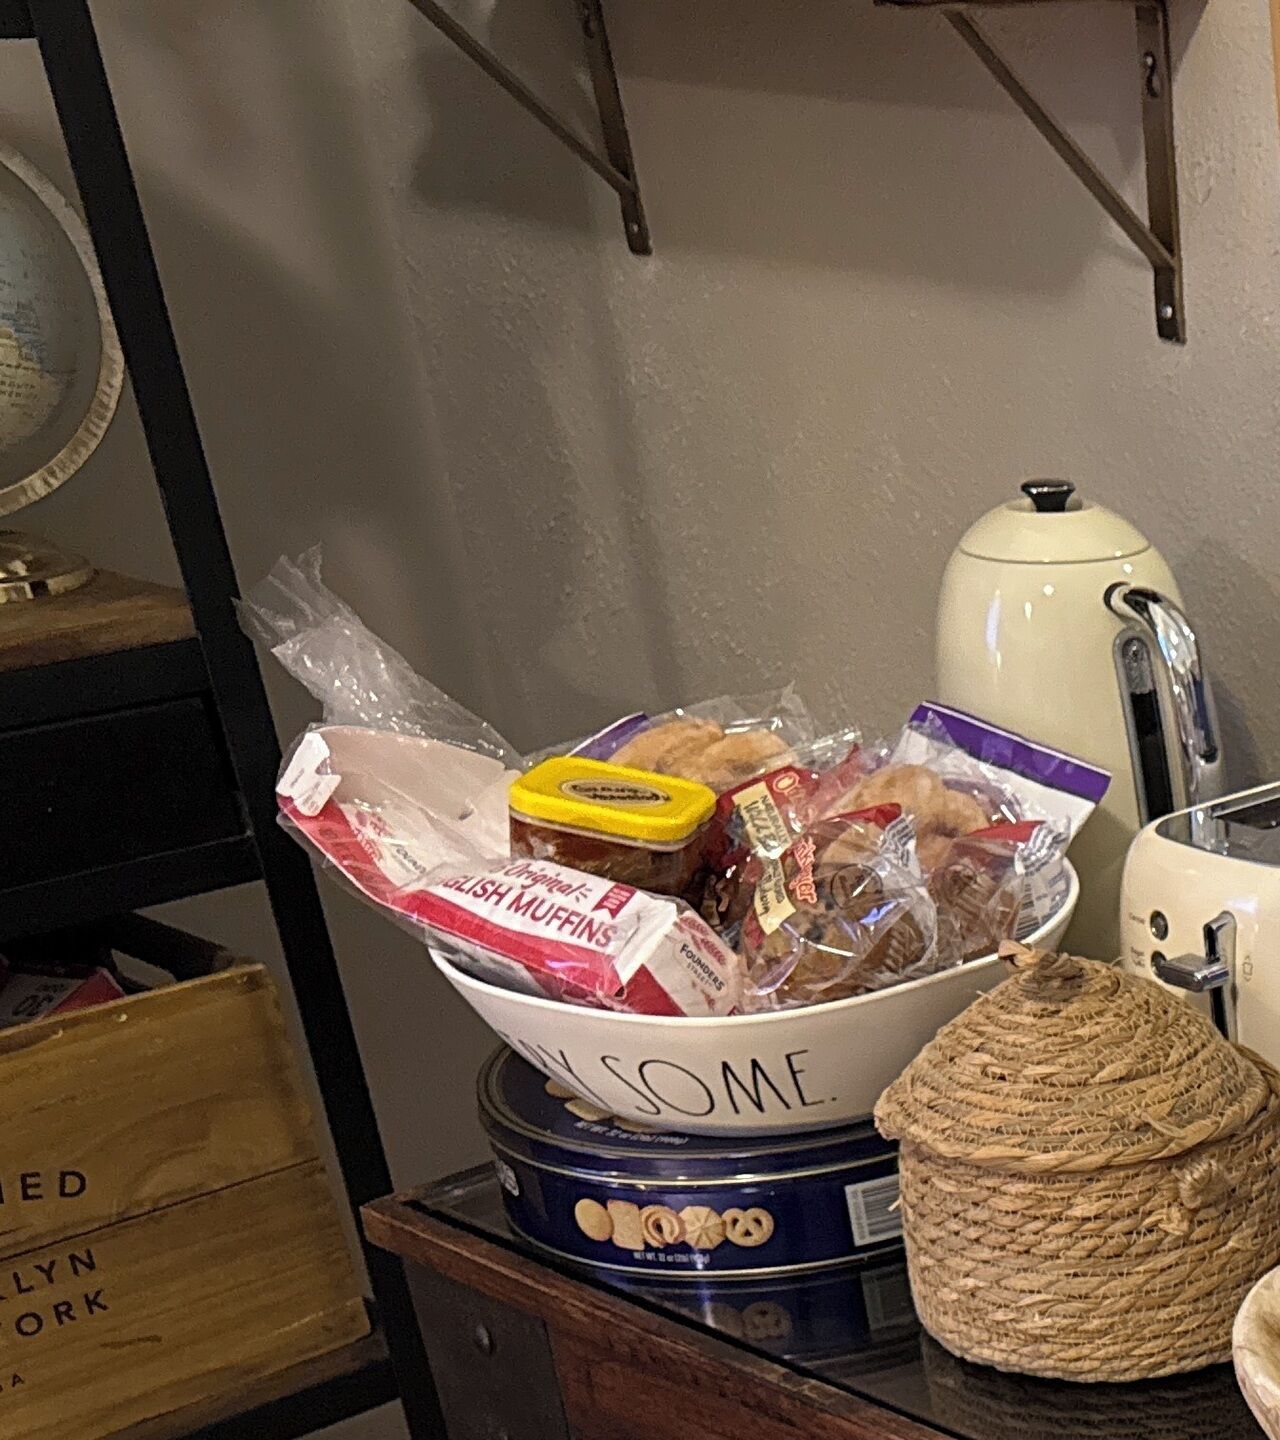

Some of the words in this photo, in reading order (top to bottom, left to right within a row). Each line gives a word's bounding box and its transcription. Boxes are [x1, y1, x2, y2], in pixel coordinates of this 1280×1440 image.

[504, 862, 580, 898] Original
[443, 875, 512, 906] GLISH
[507, 890, 618, 949] MUFFINS
[680, 943, 726, 992] FOUNDERS
[599, 1049, 838, 1117] SOME.
[0, 1170, 86, 1204] ED
[0, 1248, 96, 1300] LYN
[1, 1289, 108, 1337] ORK
